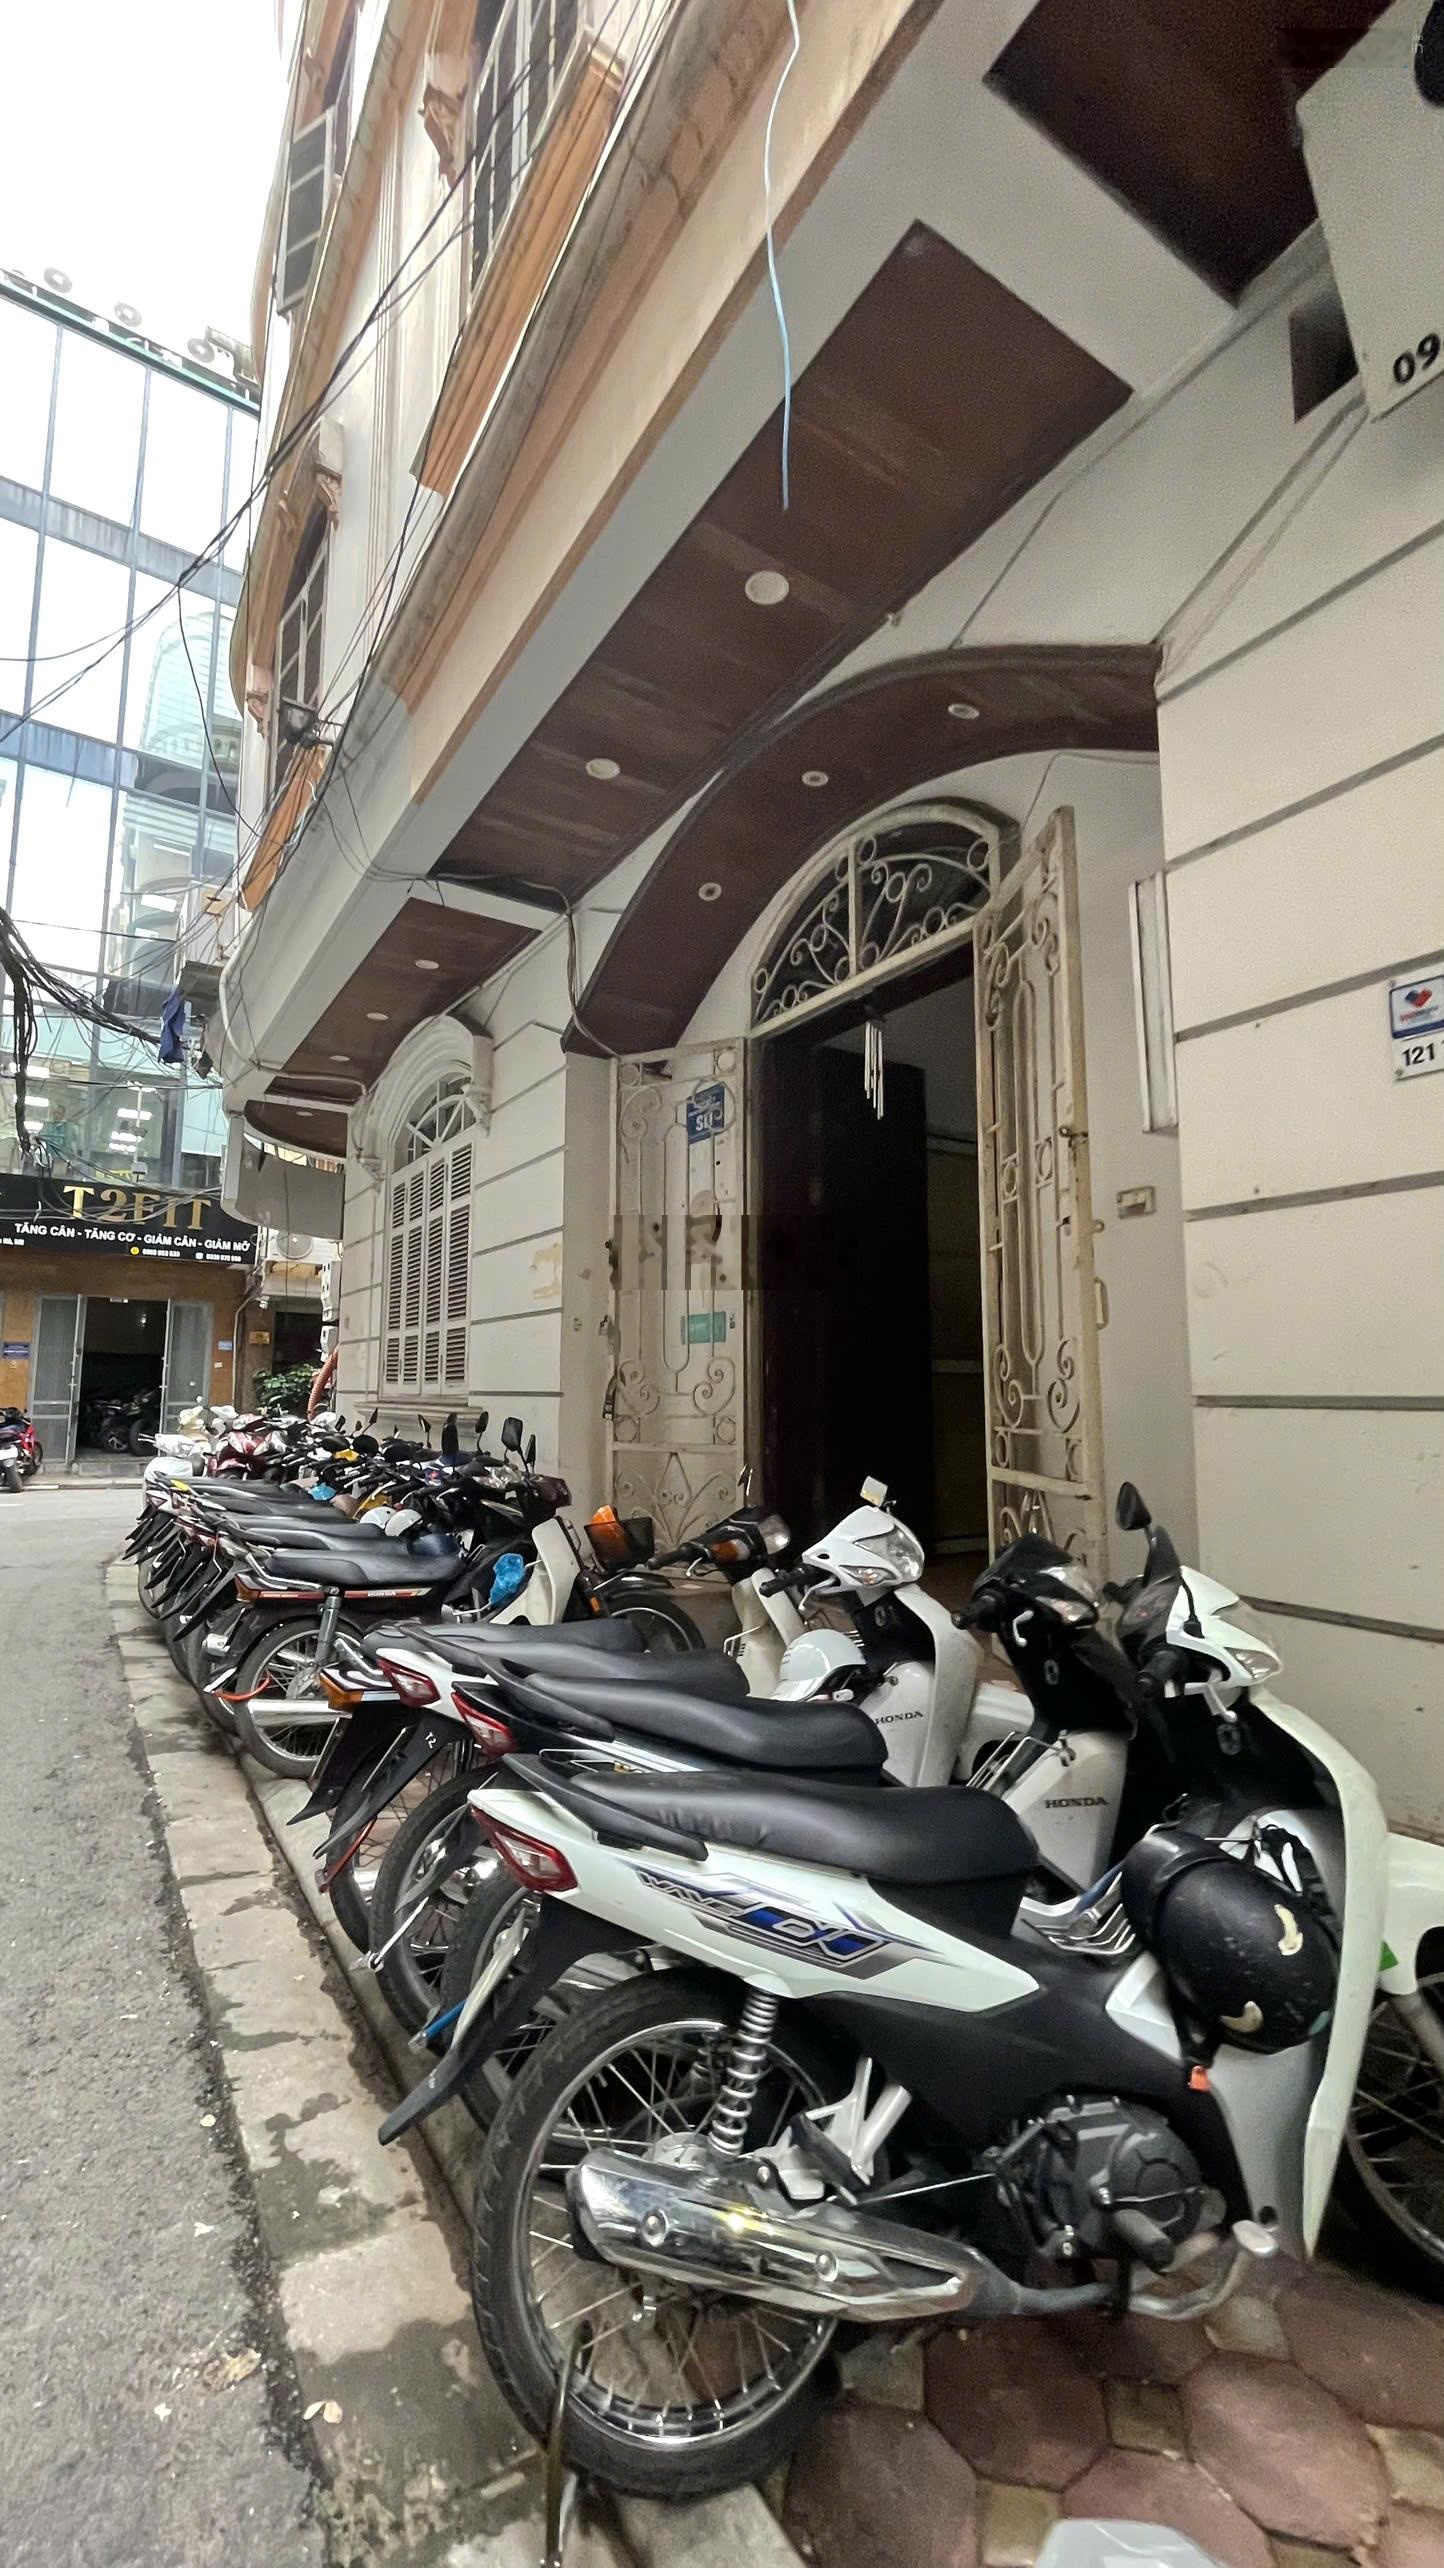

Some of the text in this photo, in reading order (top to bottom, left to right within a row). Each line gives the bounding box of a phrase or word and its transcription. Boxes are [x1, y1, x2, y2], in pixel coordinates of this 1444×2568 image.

[1392, 333, 1444, 385] 09
[1401, 1042, 1435, 1067] 121
[14, 1221, 48, 1235] TĂNG
[50, 1224, 75, 1238] CÂN
[84, 1227, 116, 1241] TĂNG
[117, 1231, 136, 1243] CƠ
[143, 1232, 172, 1246] GIẢM
[204, 1238, 231, 1251] GIẢM
[232, 1239, 251, 1252] MỠ
[874, 1711, 924, 1725] HONDA
[1045, 1796, 1111, 1809] HONDA
